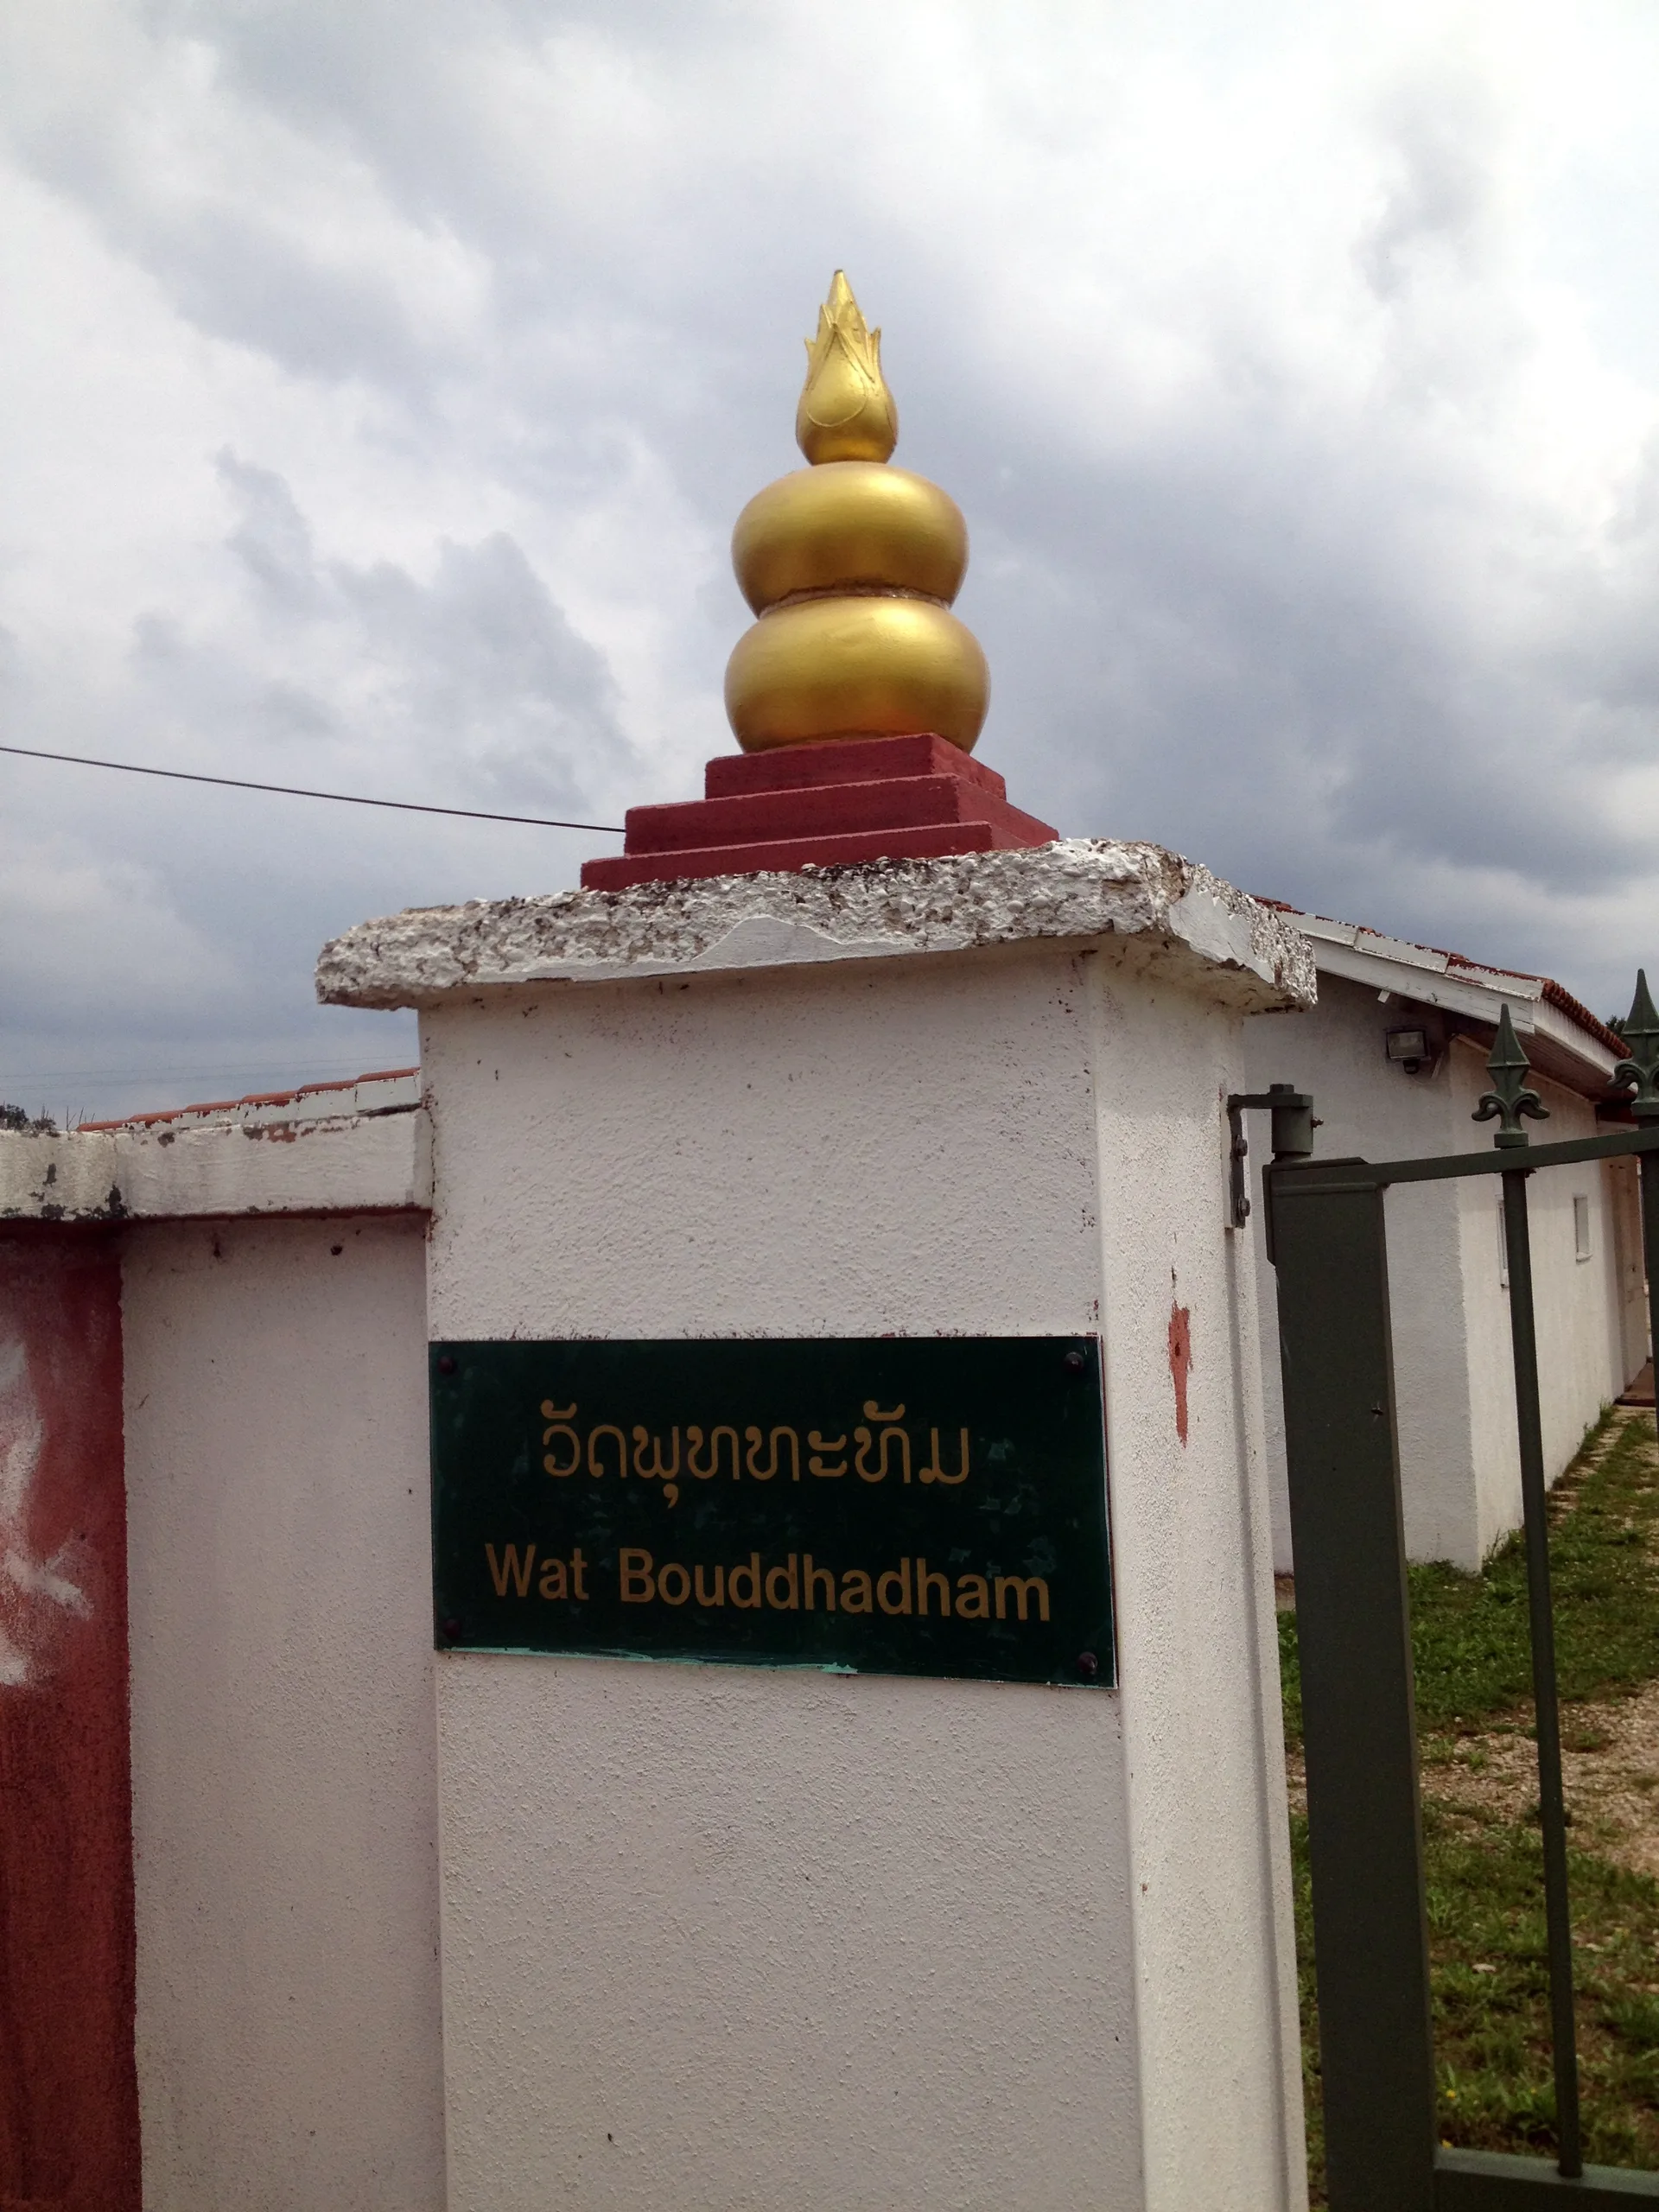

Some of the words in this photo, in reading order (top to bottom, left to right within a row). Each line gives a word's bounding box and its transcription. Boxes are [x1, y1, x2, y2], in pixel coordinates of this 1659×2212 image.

[540, 1399, 970, 1509] ວັດພຸທທະທັມ
[486, 1543, 589, 1600] Wat
[619, 1547, 1051, 1622] Bouddhadham
